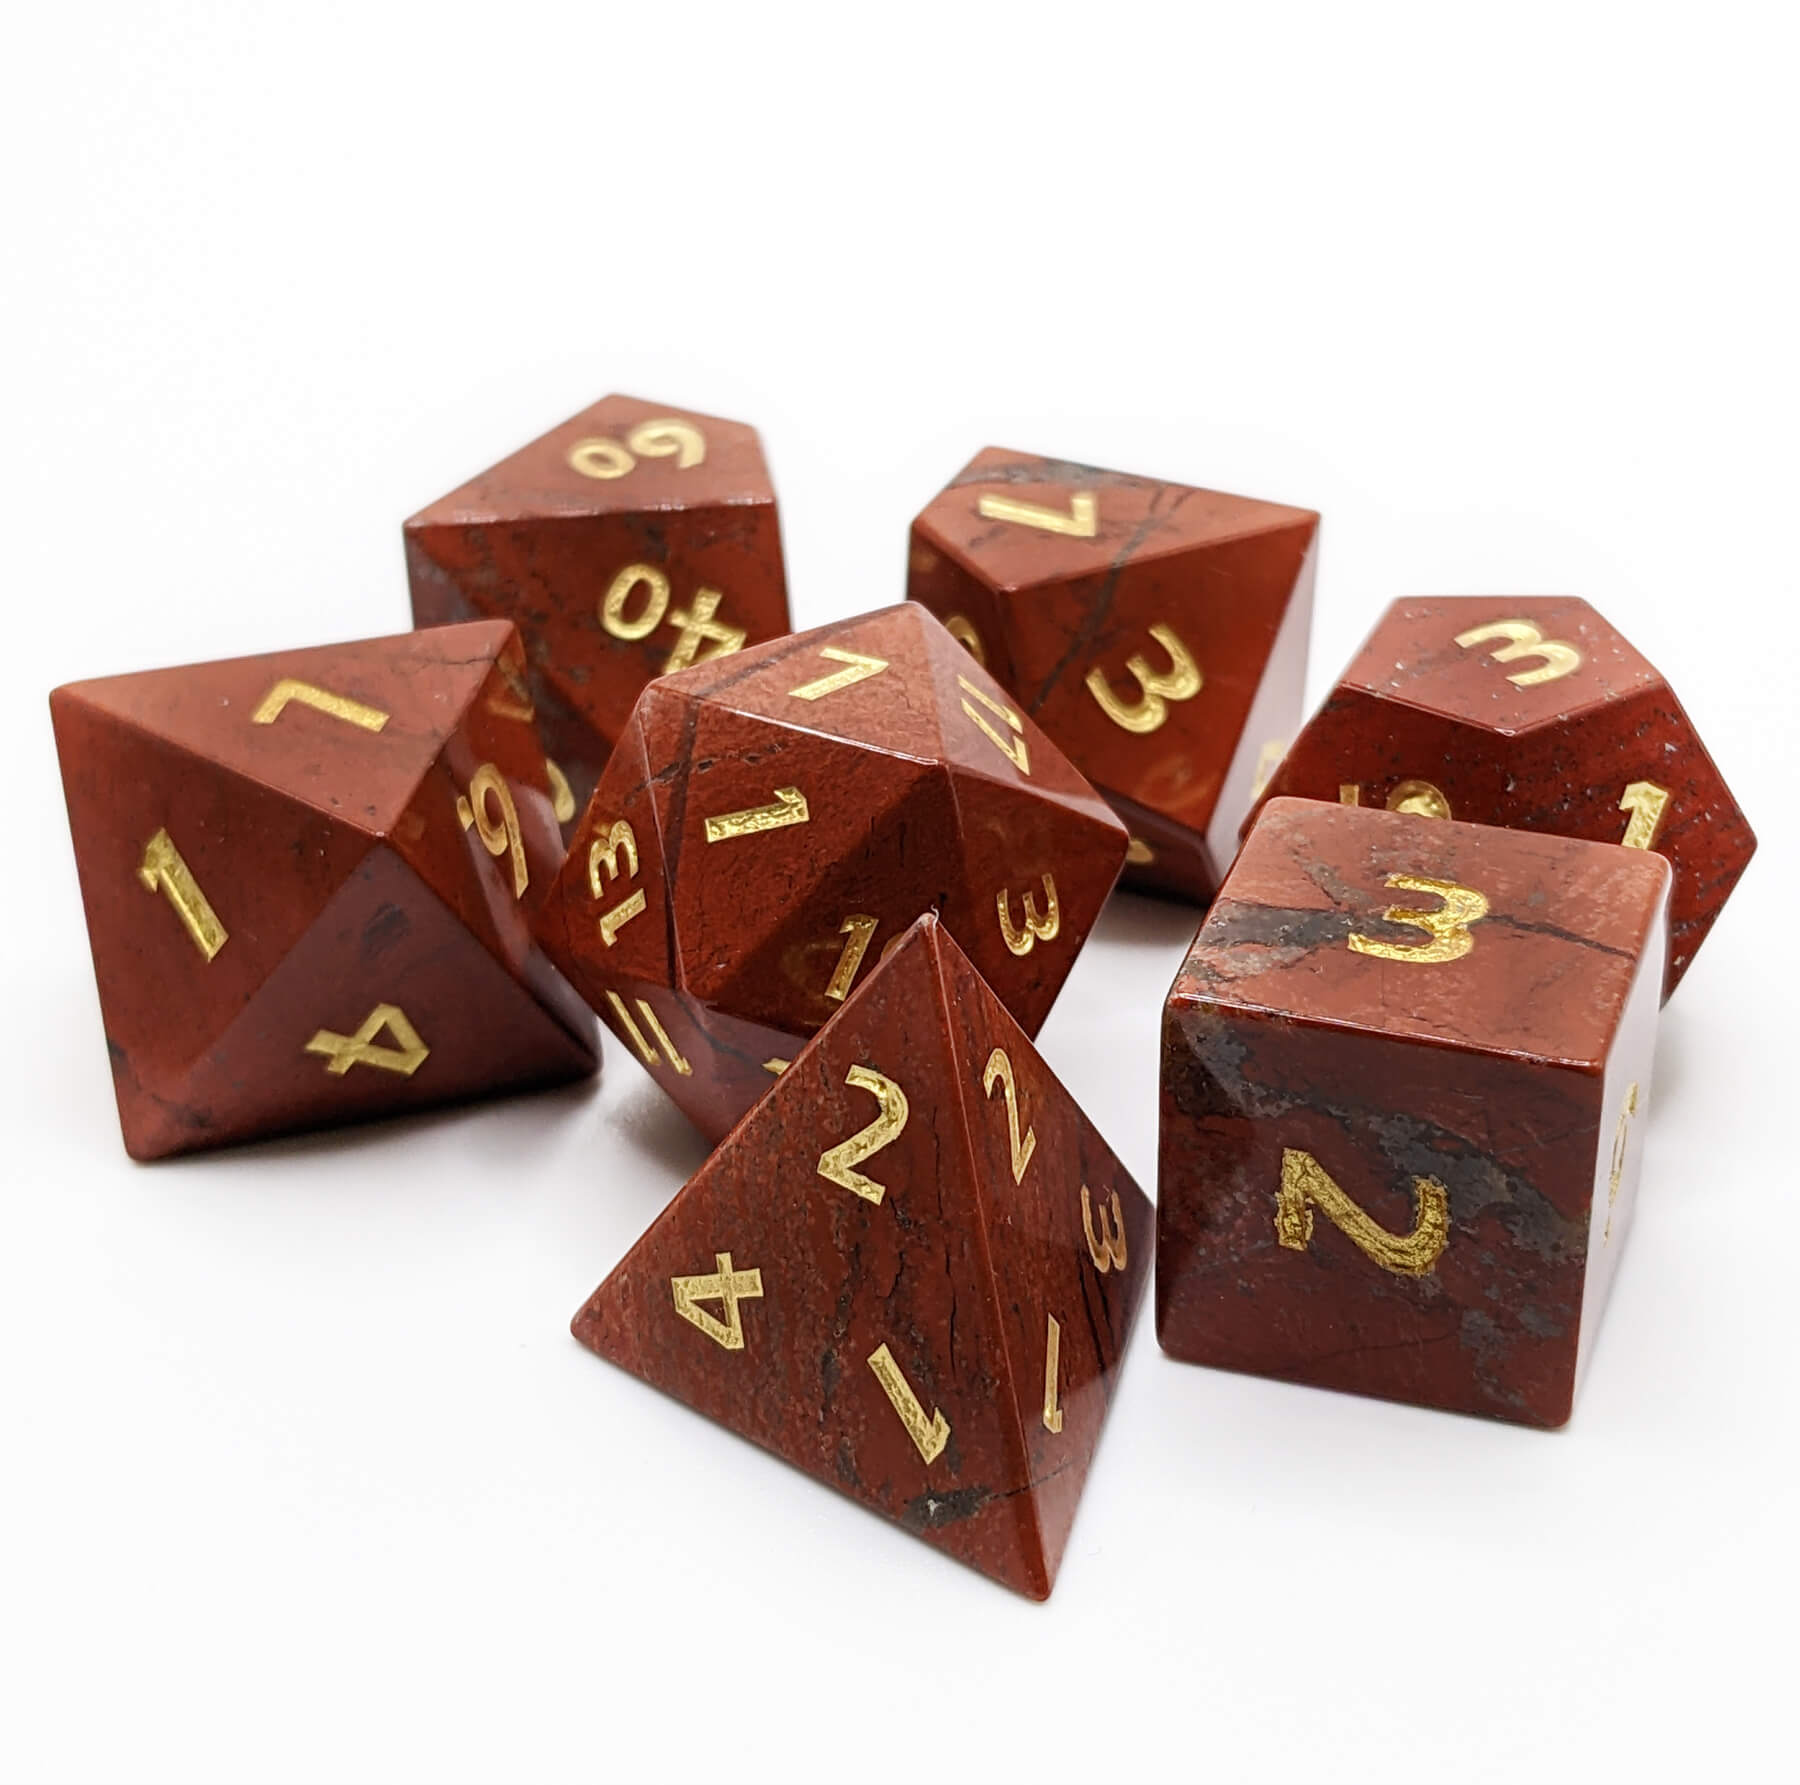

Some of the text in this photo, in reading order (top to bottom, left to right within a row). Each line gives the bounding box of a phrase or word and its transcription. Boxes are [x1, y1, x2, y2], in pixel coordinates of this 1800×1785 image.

[978, 490, 1097, 538] 7
[600, 561, 746, 676] 40
[1455, 617, 1581, 687] 3
[1085, 623, 1204, 735] 3
[704, 785, 810, 845] 1
[137, 827, 229, 963] 1
[588, 818, 648, 947] 13
[996, 872, 1061, 957] 3
[1344, 872, 1490, 965] 3
[304, 1002, 430, 1077] 4
[816, 1063, 909, 1206] 2
[982, 1047, 1037, 1187] 2
[1079, 1183, 1128, 1274] 3
[1274, 1147, 1451, 1278] 2
[670, 1251, 764, 1352] 4
[866, 1342, 952, 1465] 1
[1042, 1312, 1063, 1434] 1
